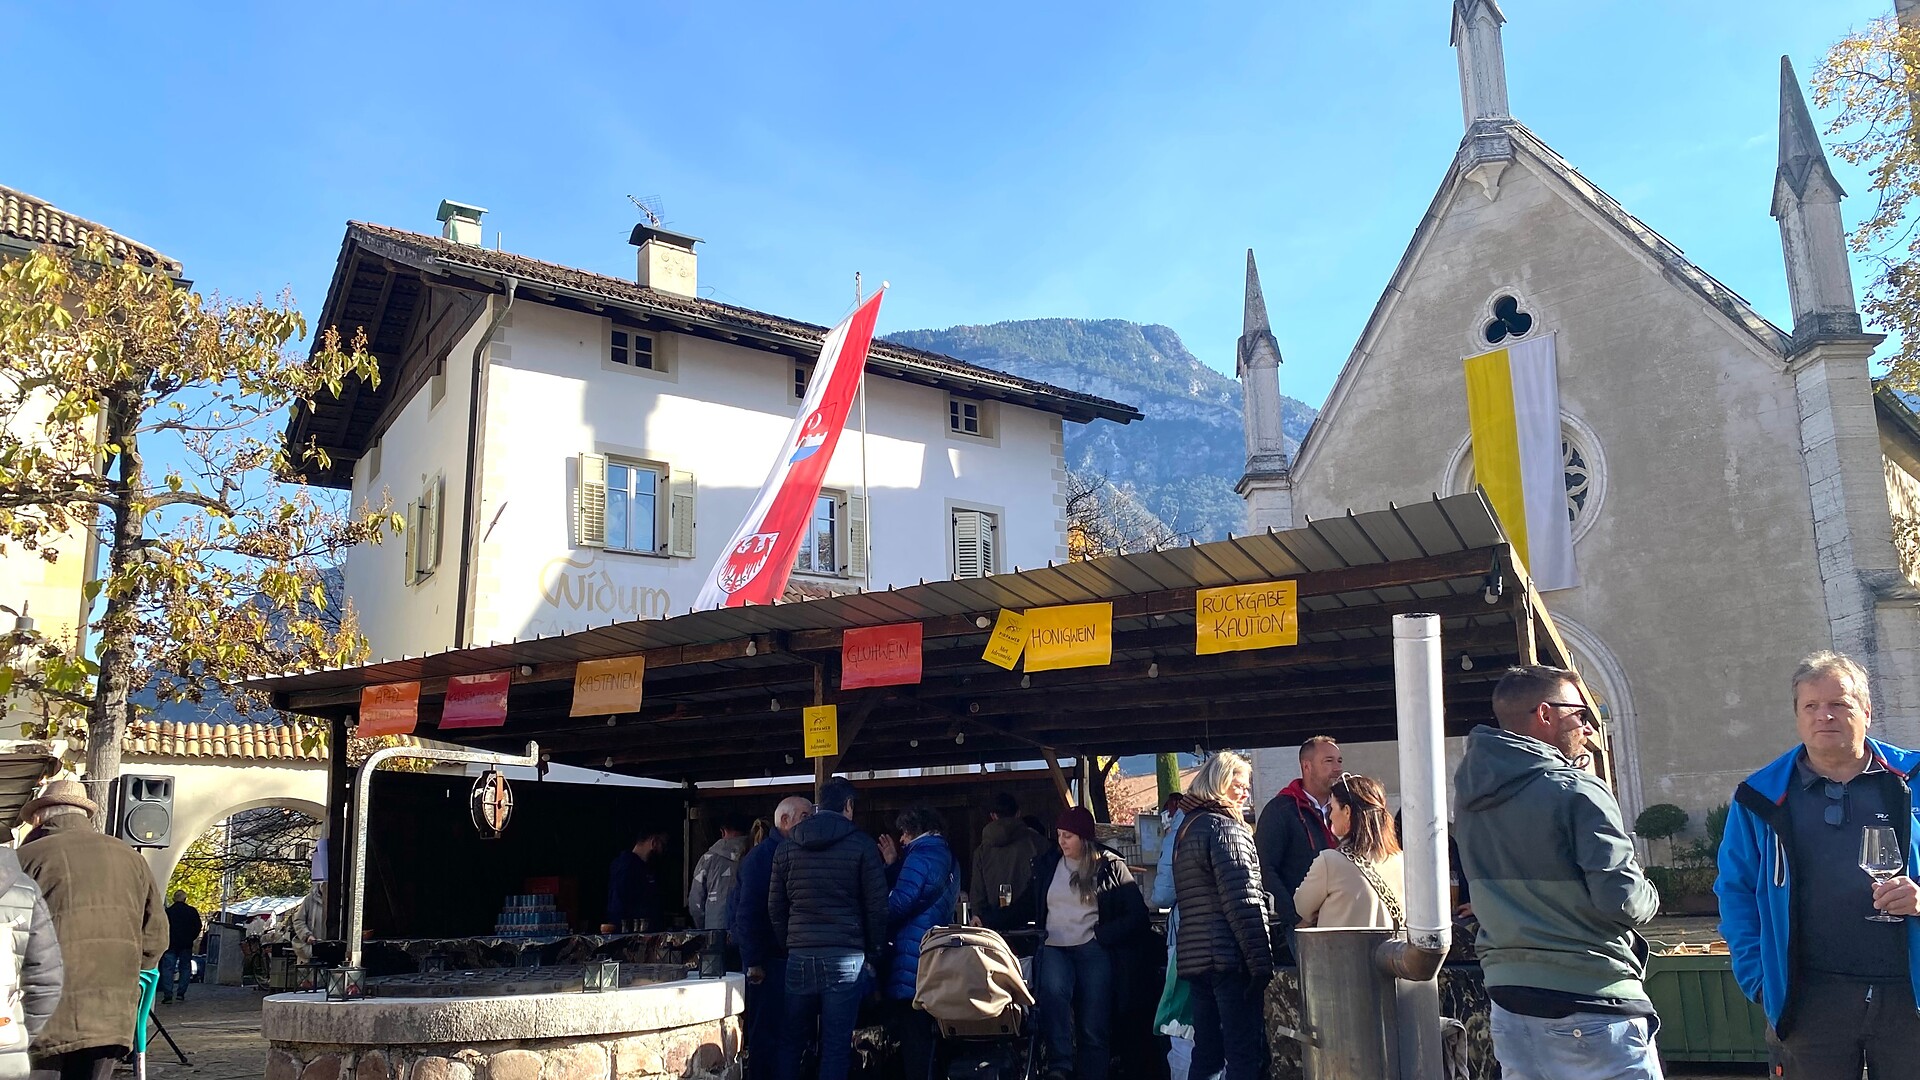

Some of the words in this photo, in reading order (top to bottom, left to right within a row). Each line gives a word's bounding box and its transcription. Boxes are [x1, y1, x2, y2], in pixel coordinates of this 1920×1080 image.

[538, 557, 671, 617] Widum
[1202, 590, 1288, 614] RÜCKGABE
[1031, 624, 1096, 648] HONIGWEIN
[1213, 610, 1286, 639] KAUTION
[579, 670, 637, 693] KASTANIEN
